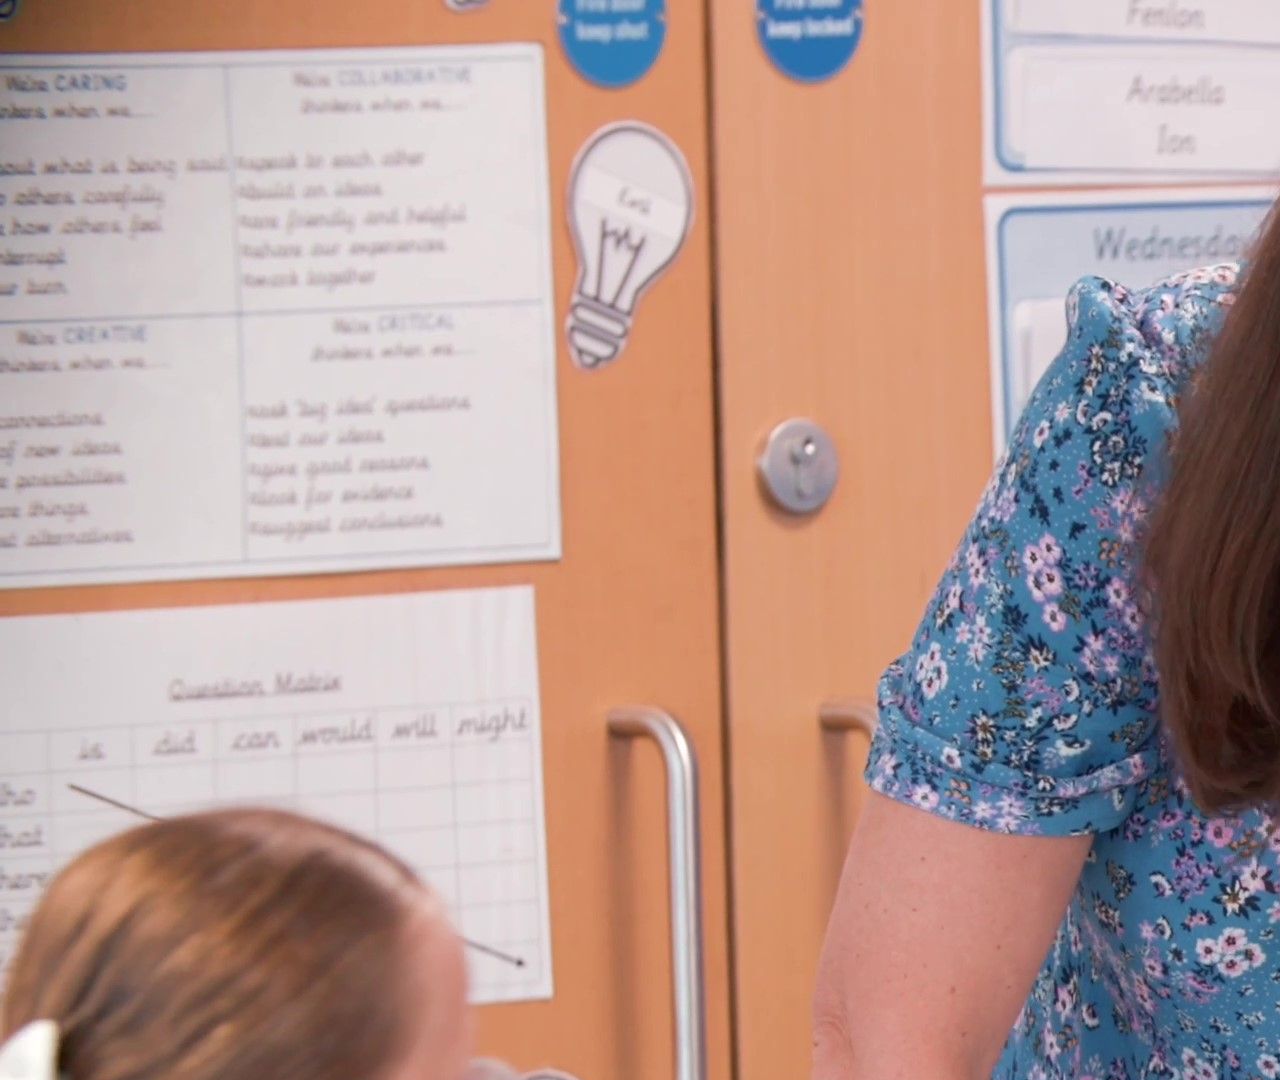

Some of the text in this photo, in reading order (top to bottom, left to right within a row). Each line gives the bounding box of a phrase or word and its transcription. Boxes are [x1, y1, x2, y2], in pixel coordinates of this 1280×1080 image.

[54, 73, 128, 92] CARING
[1125, 74, 1227, 105] Arabella
[1092, 225, 1242, 262] Wednesda
[168, 671, 342, 703] Question Matrix
[77, 707, 530, 760] is did can would will might
